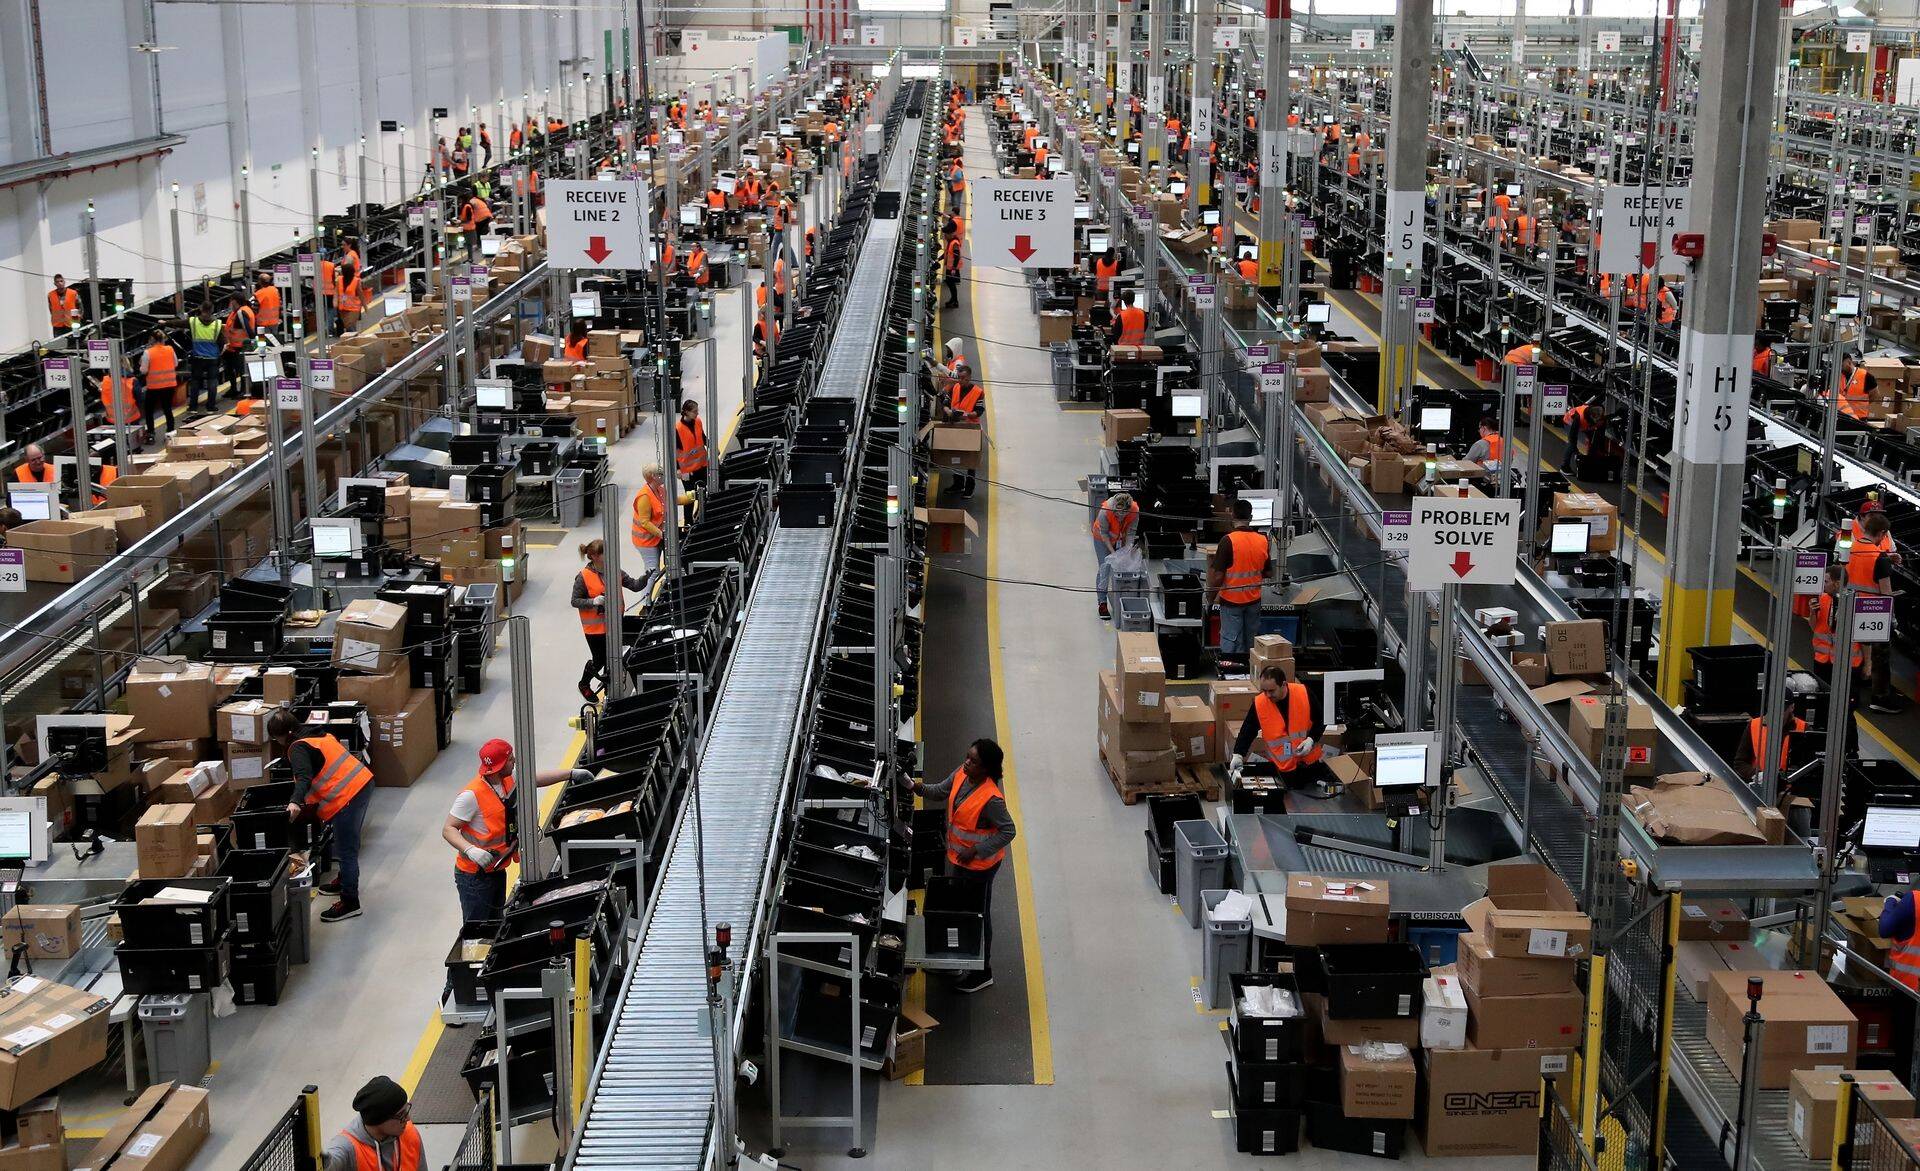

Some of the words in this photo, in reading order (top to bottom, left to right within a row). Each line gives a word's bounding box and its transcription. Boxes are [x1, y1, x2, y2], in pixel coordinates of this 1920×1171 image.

[1199, 109, 1206, 118] N
[1200, 122, 1206, 131] 5
[1272, 145, 1279, 156] L
[1272, 161, 1279, 173] 5
[566, 191, 627, 203] RECEIVE
[994, 190, 1054, 202] RECEIVE
[1624, 198, 1684, 210] RECEVE
[574, 210, 608, 221] LINE
[611, 210, 620, 221] 2
[1000, 209, 1033, 220] LINE
[1038, 209, 1046, 220] 3
[1404, 210, 1414, 226] J
[1630, 216, 1660, 227] LINE
[1666, 216, 1674, 227] 4
[1402, 234, 1412, 249] 5
[1714, 367, 1736, 393] H
[1714, 405, 1731, 431] 5
[1420, 510, 1510, 526] PROBLEM
[1387, 532, 1408, 541] 3-29
[1434, 530, 1494, 546] SOLVE
[0, 572, 18, 581] -29
[1795, 576, 1818, 584] 4-29
[1859, 622, 1883, 630] 4-30
